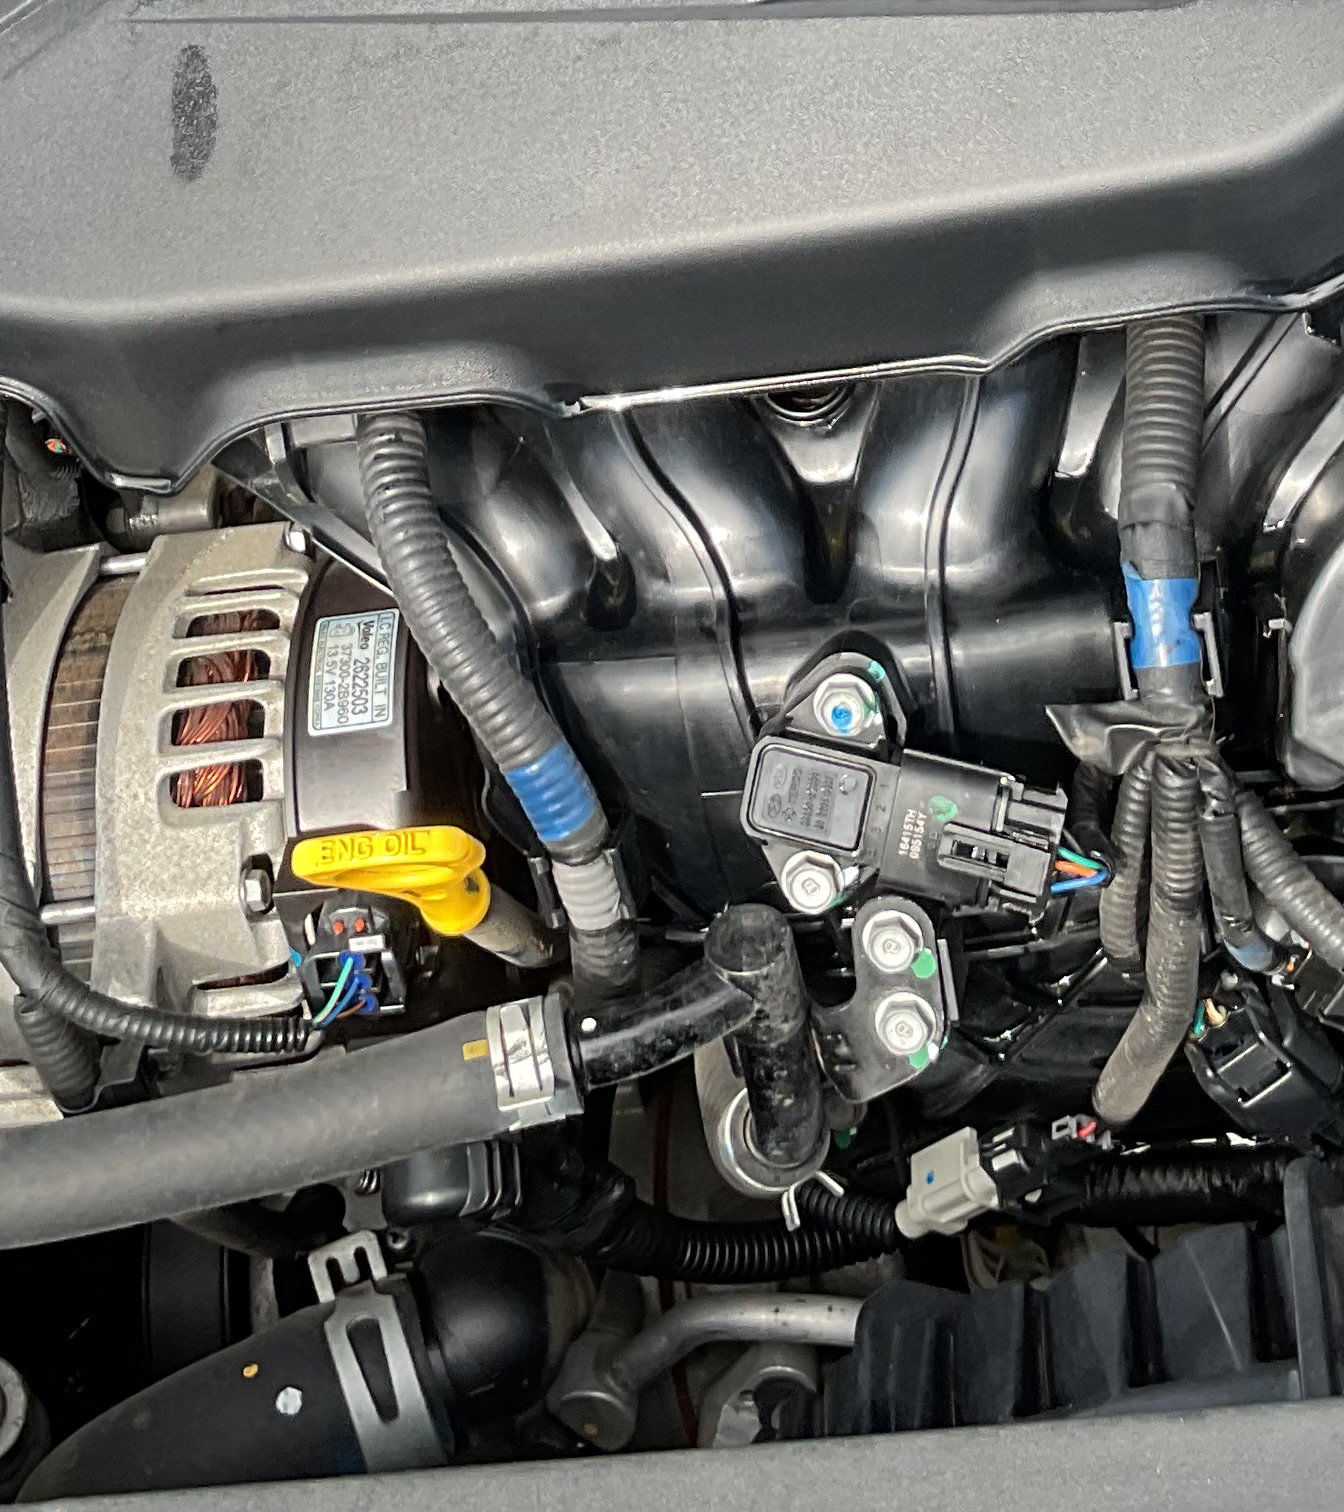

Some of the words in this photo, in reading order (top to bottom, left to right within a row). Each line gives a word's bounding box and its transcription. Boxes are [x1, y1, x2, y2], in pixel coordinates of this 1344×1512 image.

[361, 621, 375, 650] Valeo
[323, 680, 336, 711] 130A
[337, 643, 353, 724] 37300-2B960
[351, 658, 369, 715] 2622503
[374, 663, 387, 696] BUILT
[374, 704, 386, 718] IN
[317, 835, 374, 867] ENG
[384, 829, 430, 858] OIL
